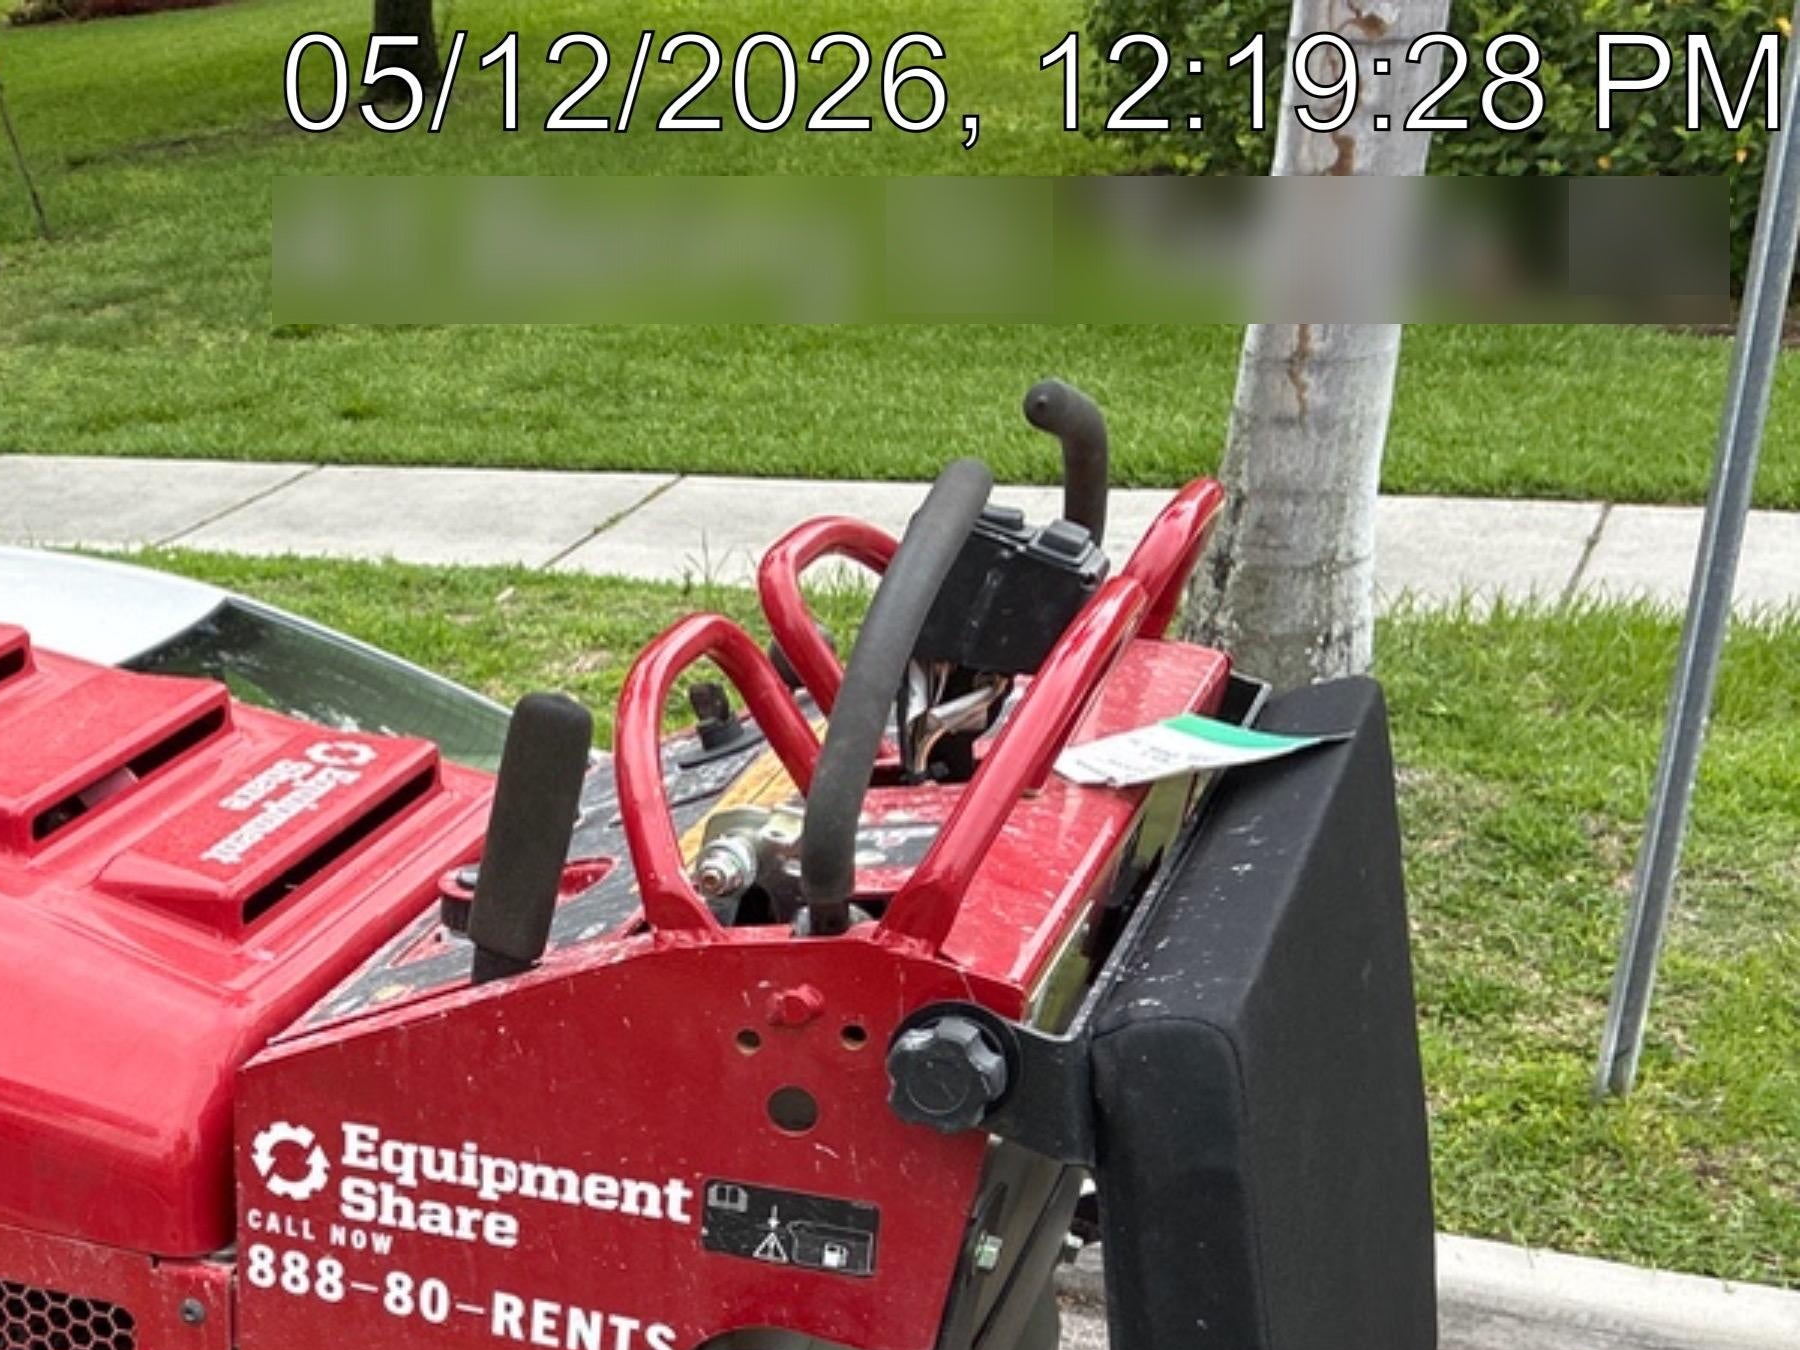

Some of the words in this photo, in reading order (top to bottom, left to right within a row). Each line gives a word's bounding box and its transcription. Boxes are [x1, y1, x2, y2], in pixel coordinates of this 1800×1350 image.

[341, 1121, 694, 1225] Equipment
[247, 1208, 316, 1241] CALL
[329, 1223, 394, 1256] NOW
[340, 1176, 520, 1249] Share
